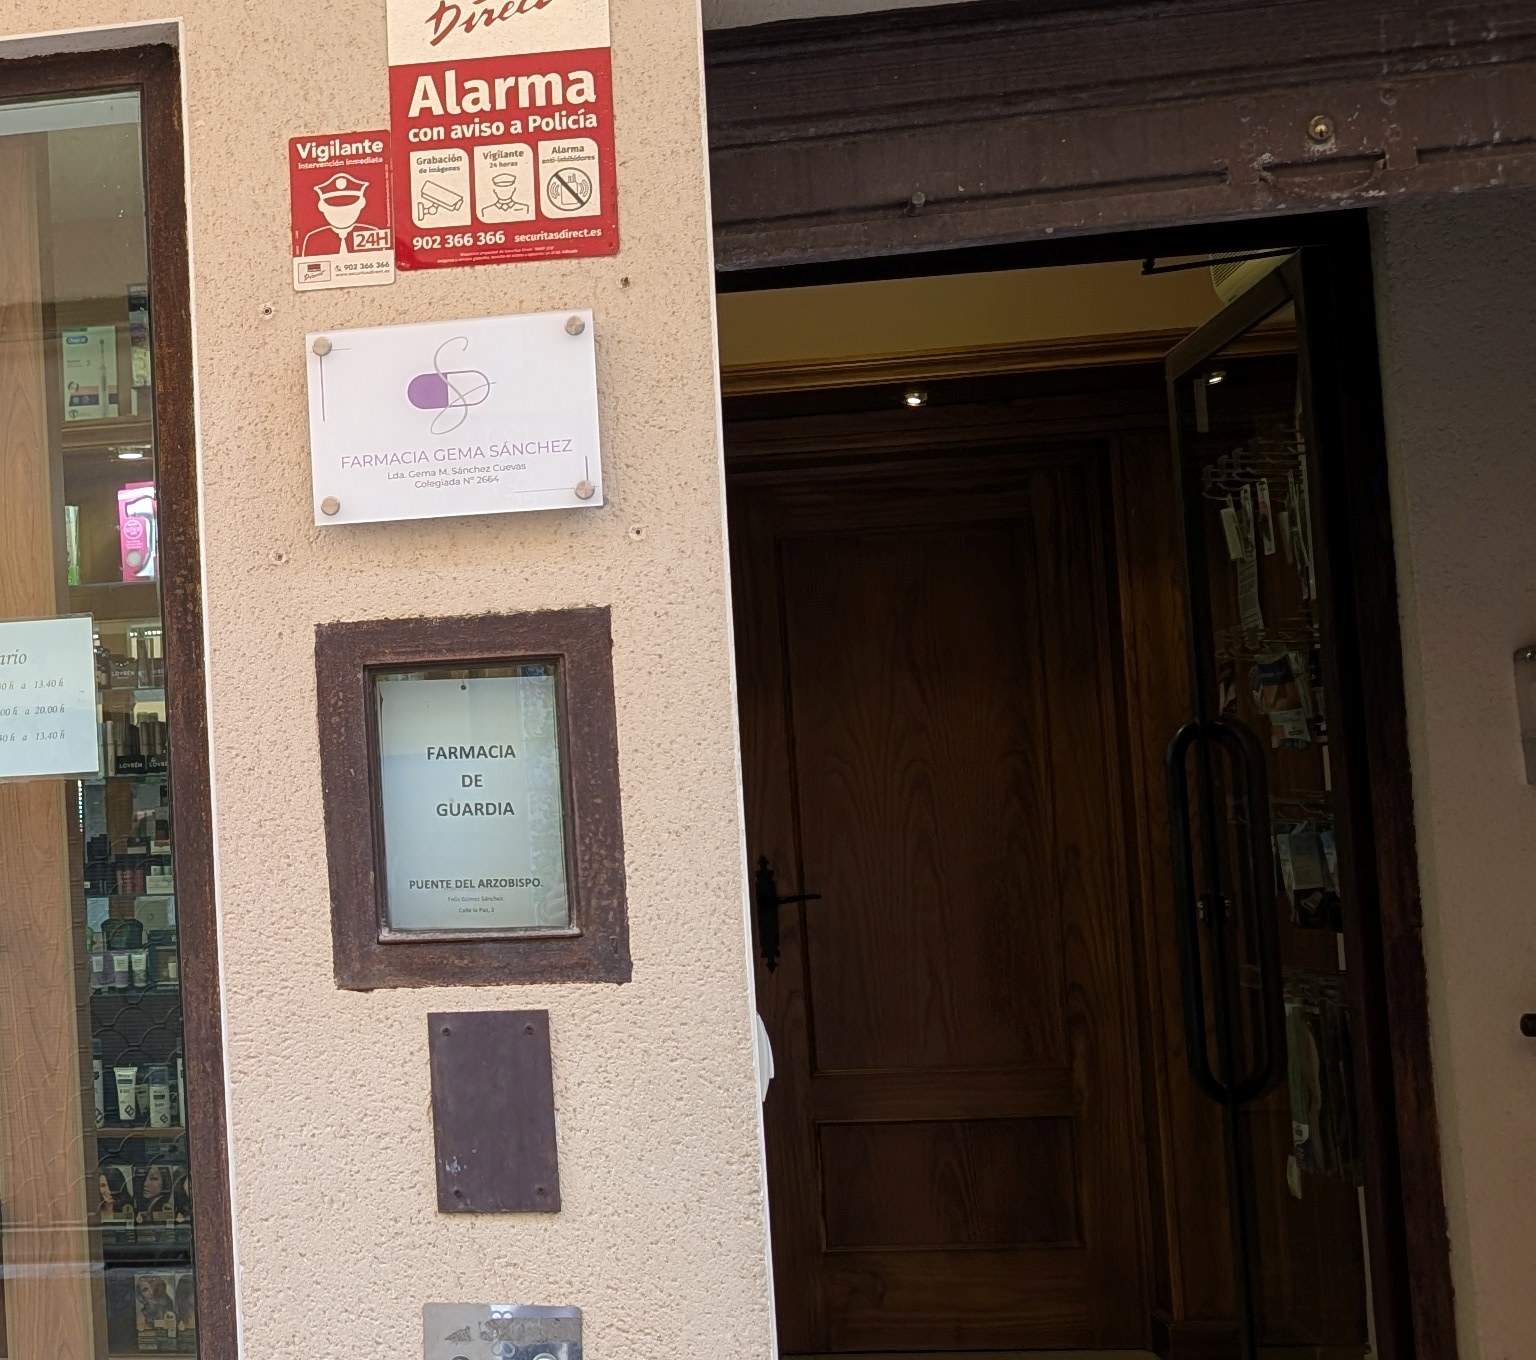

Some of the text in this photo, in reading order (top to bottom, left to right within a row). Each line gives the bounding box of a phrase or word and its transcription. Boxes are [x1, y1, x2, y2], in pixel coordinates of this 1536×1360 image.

[407, 69, 596, 118] Alarma
[408, 109, 598, 143] con aviso a Policía
[296, 139, 384, 162] Vigilante
[483, 149, 524, 161] Vigilante
[551, 145, 585, 155] Alarma
[416, 154, 463, 166] Grabación
[355, 231, 389, 248] 24H
[413, 231, 506, 250] 902 366 366
[514, 228, 602, 244] securitasdirect.es
[341, 439, 573, 469] FARMACIA GEMA SÁNCHEZ
[387, 462, 527, 480] Lda. Gema M. Sánchez Cuevas
[414, 477, 461, 488] Colegiada
[476, 475, 500, 484] 2664
[34, 680, 57, 689] 13.40
[34, 706, 58, 715] 20.00
[35, 732, 58, 741] 13.40
[427, 745, 517, 760] FARMACIA
[461, 774, 483, 788] DE
[436, 801, 515, 817] GUARDIA
[409, 877, 544, 890] PUENTE DEL ARZOBISPO.
